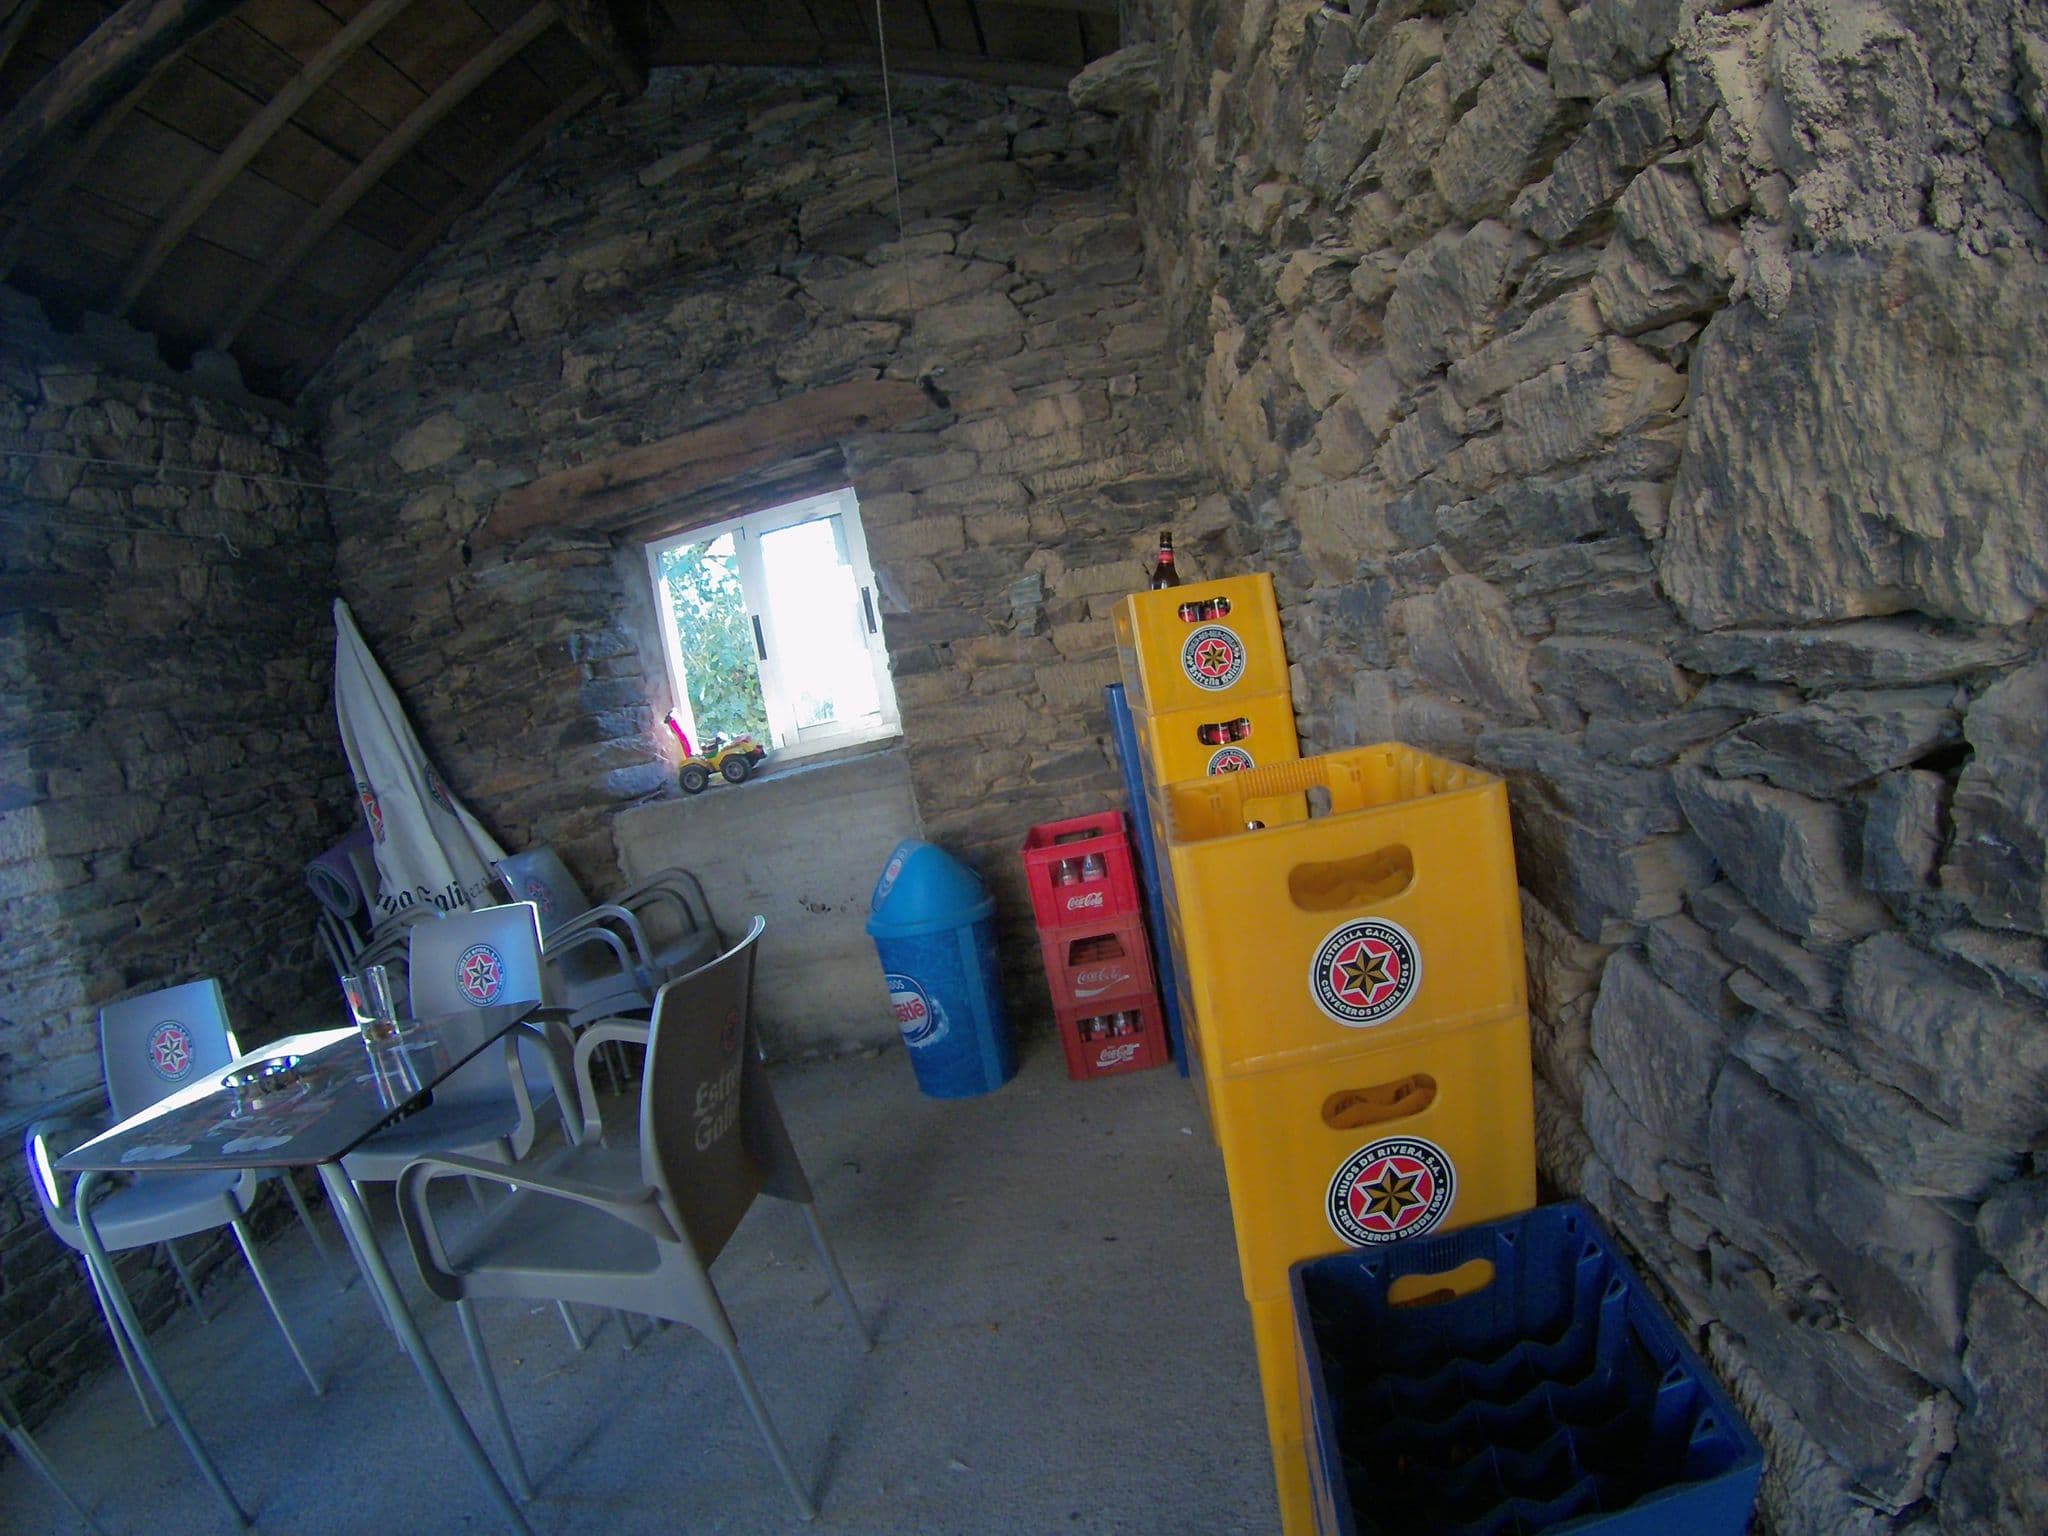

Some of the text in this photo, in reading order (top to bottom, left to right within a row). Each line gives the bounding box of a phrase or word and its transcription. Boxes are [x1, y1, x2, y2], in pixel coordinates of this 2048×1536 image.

[1323, 928, 1402, 966] ESTRELLA GALICIA
[1321, 963, 1409, 1016] CERVECEROS DESDE 1906
[1338, 1145, 1441, 1197] HIJOS DE RIVERA, S.A.
[1338, 1188, 1444, 1241] CERVECEROS DESDE 1906
